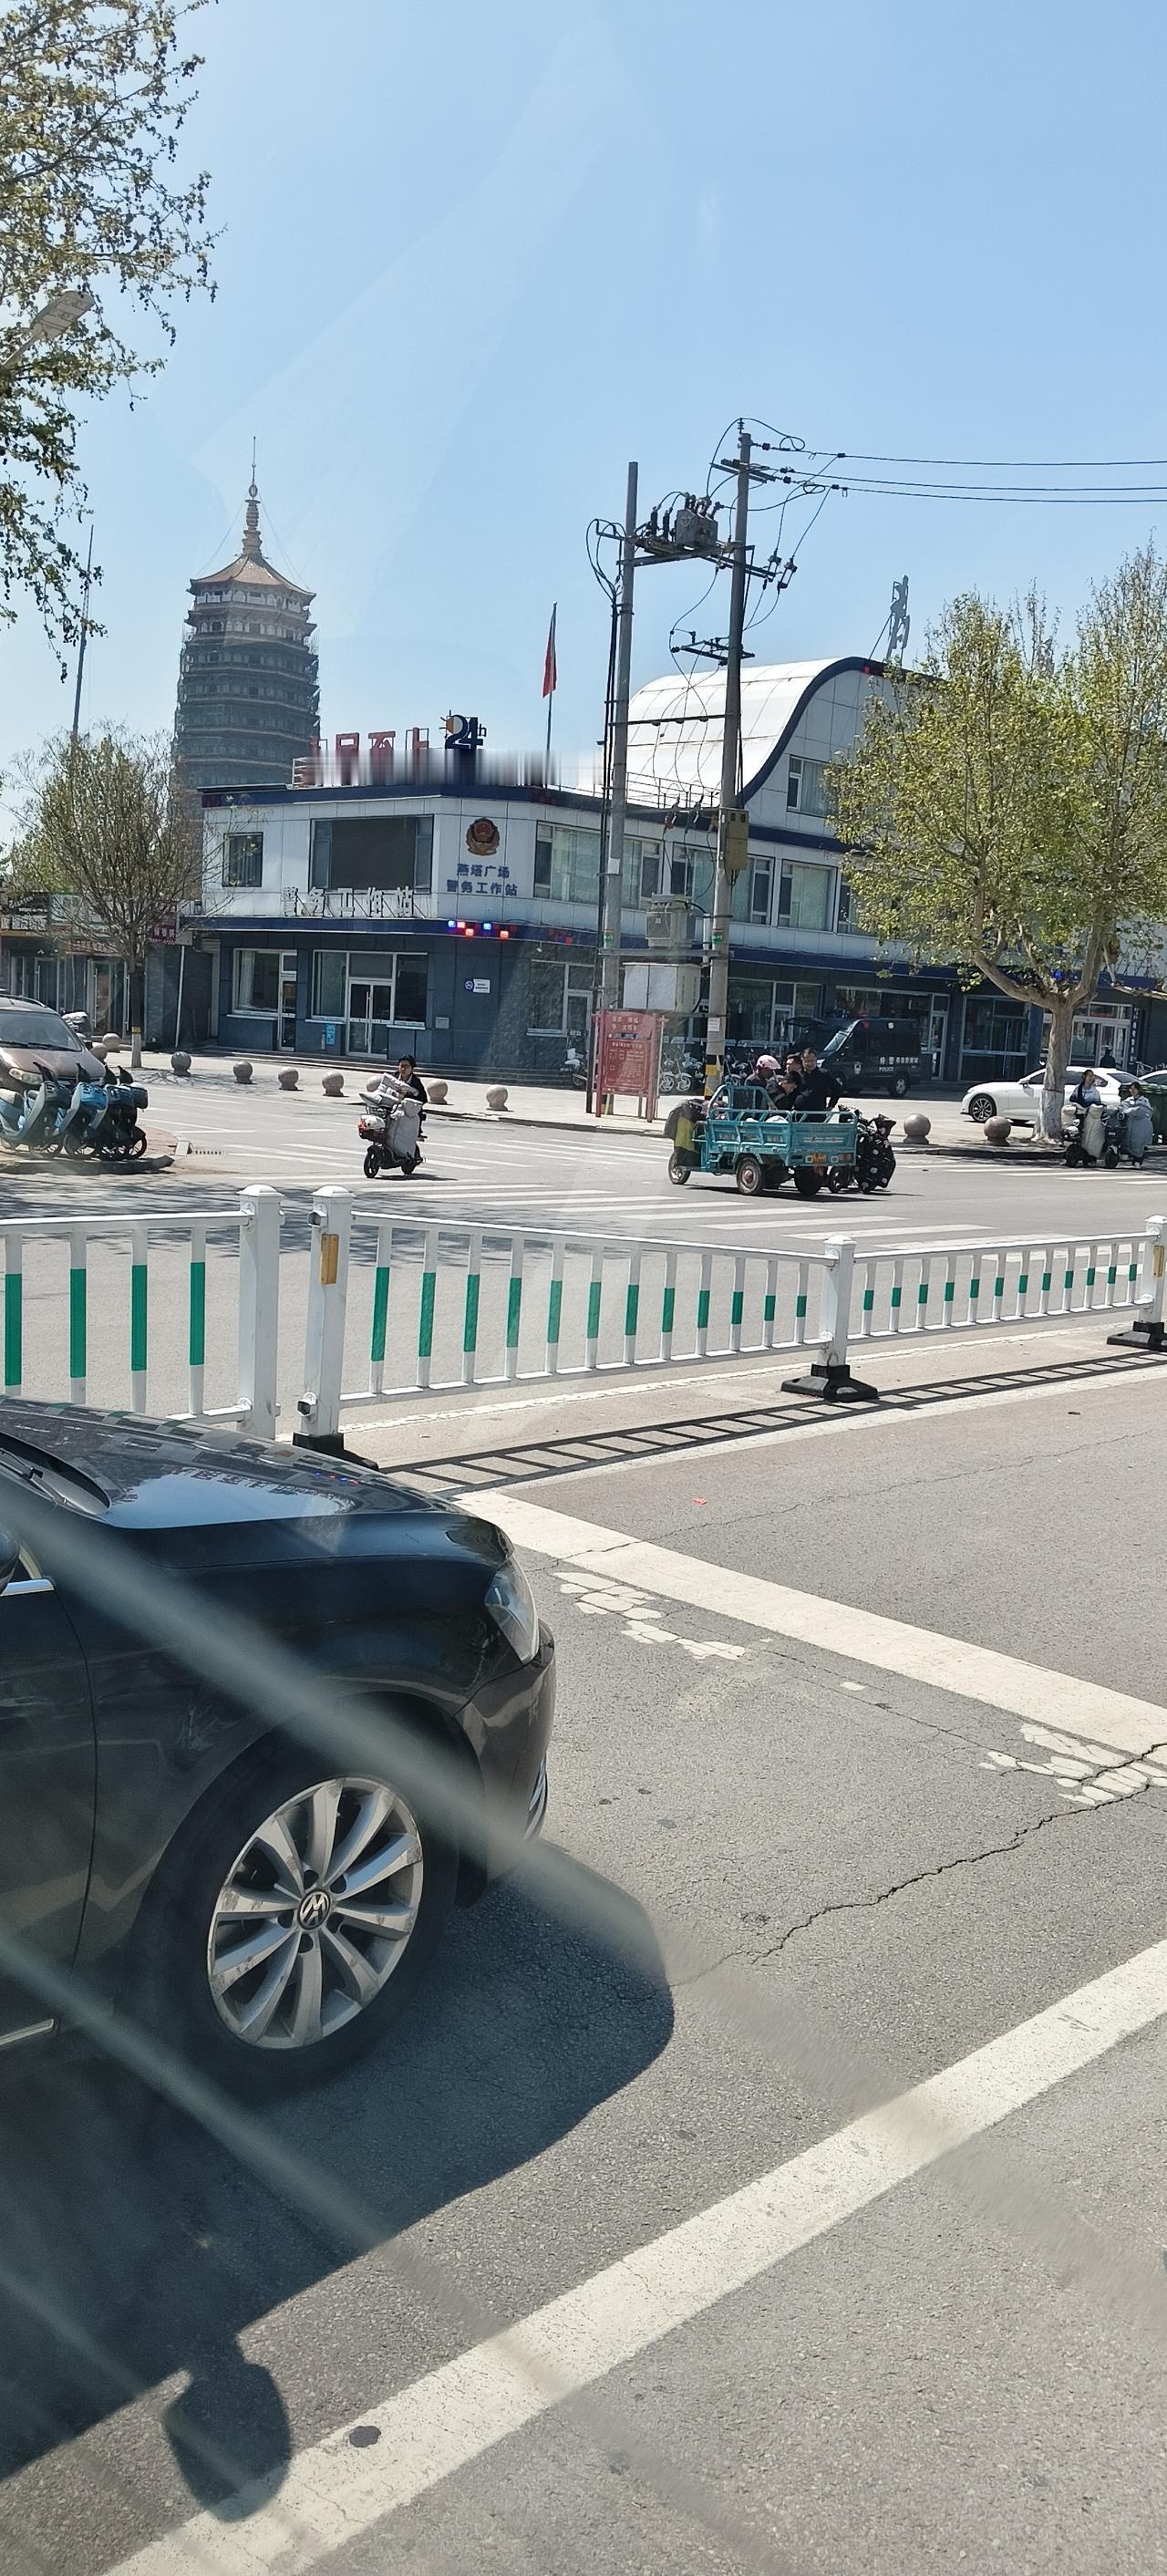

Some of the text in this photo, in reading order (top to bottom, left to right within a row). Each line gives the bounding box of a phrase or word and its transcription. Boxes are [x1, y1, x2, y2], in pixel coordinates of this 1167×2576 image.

[447, 879, 518, 896] 警务工作站
[282, 885, 414, 917] 警务工作站
